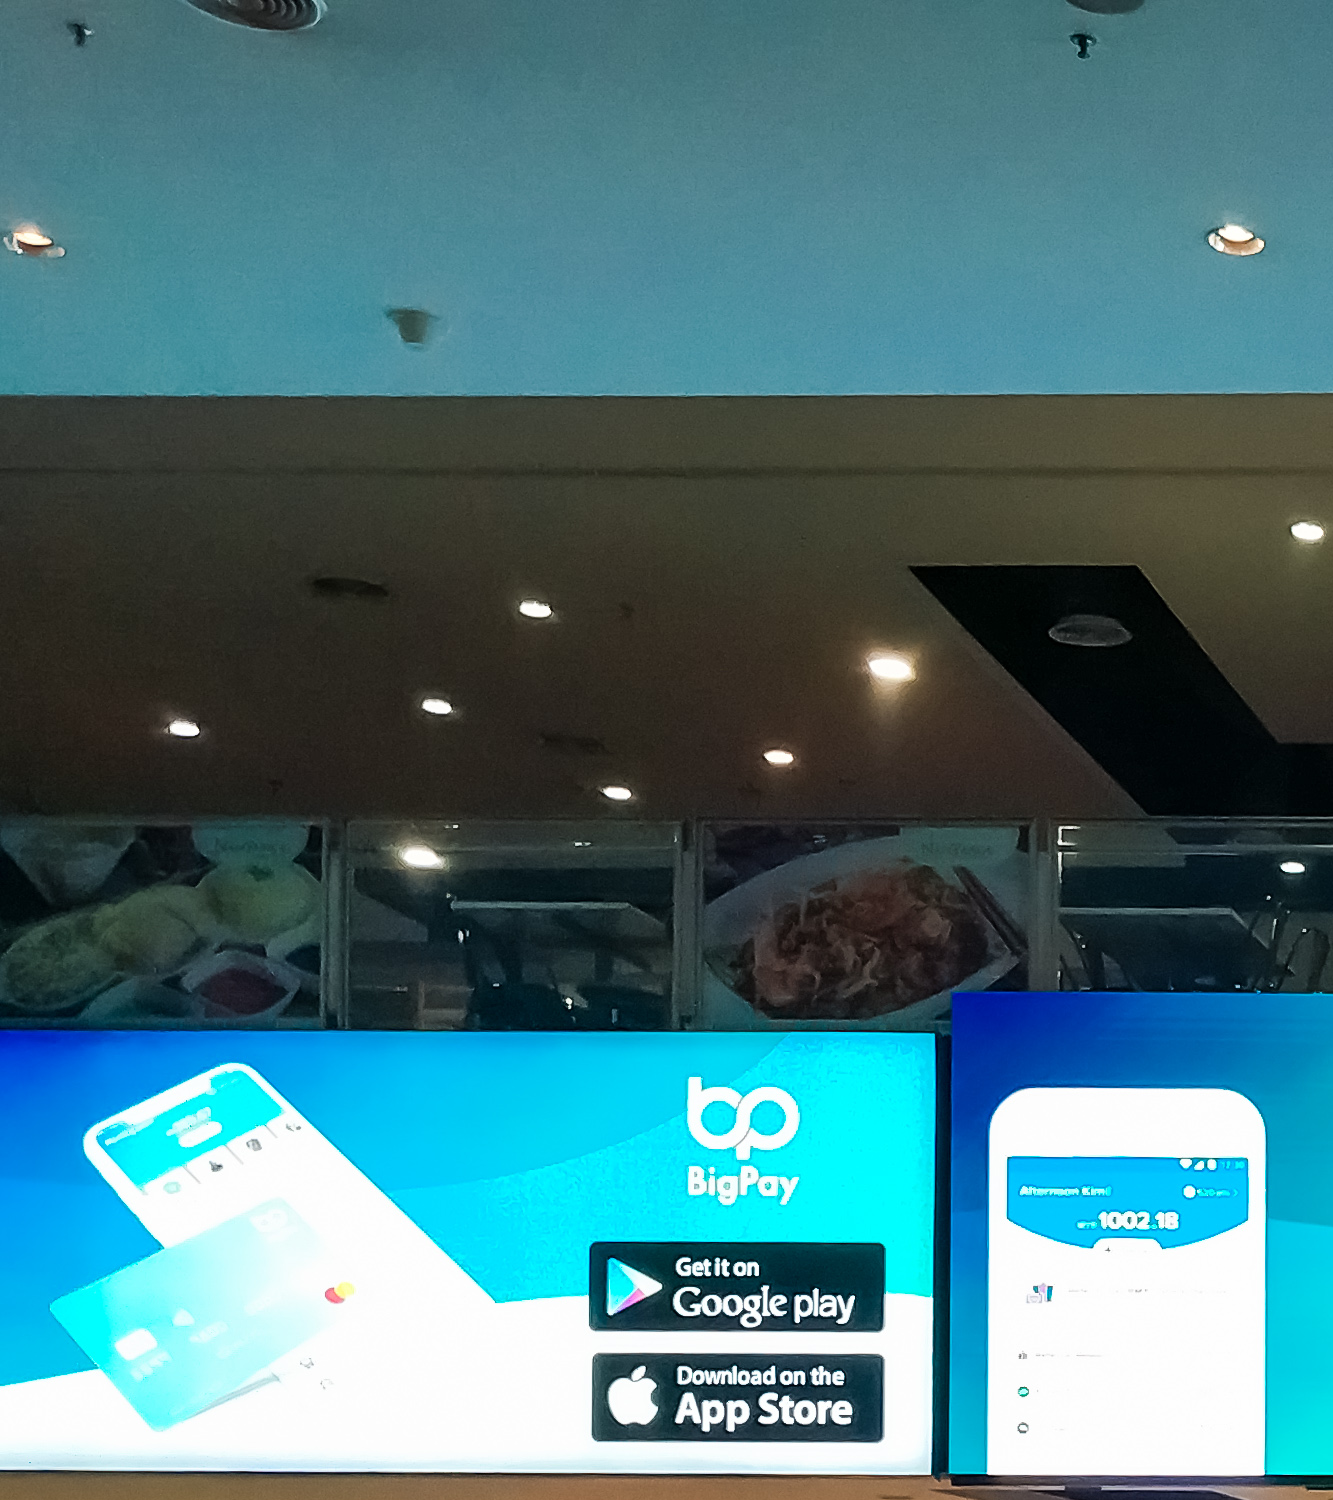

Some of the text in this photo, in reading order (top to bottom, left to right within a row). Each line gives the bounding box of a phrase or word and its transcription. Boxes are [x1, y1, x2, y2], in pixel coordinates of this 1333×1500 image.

[687, 1165, 800, 1206] BigPay
[675, 1257, 760, 1277] Get it on
[672, 1285, 856, 1328] Google play
[676, 1365, 845, 1386] Download on the
[674, 1391, 853, 1433] App Store
